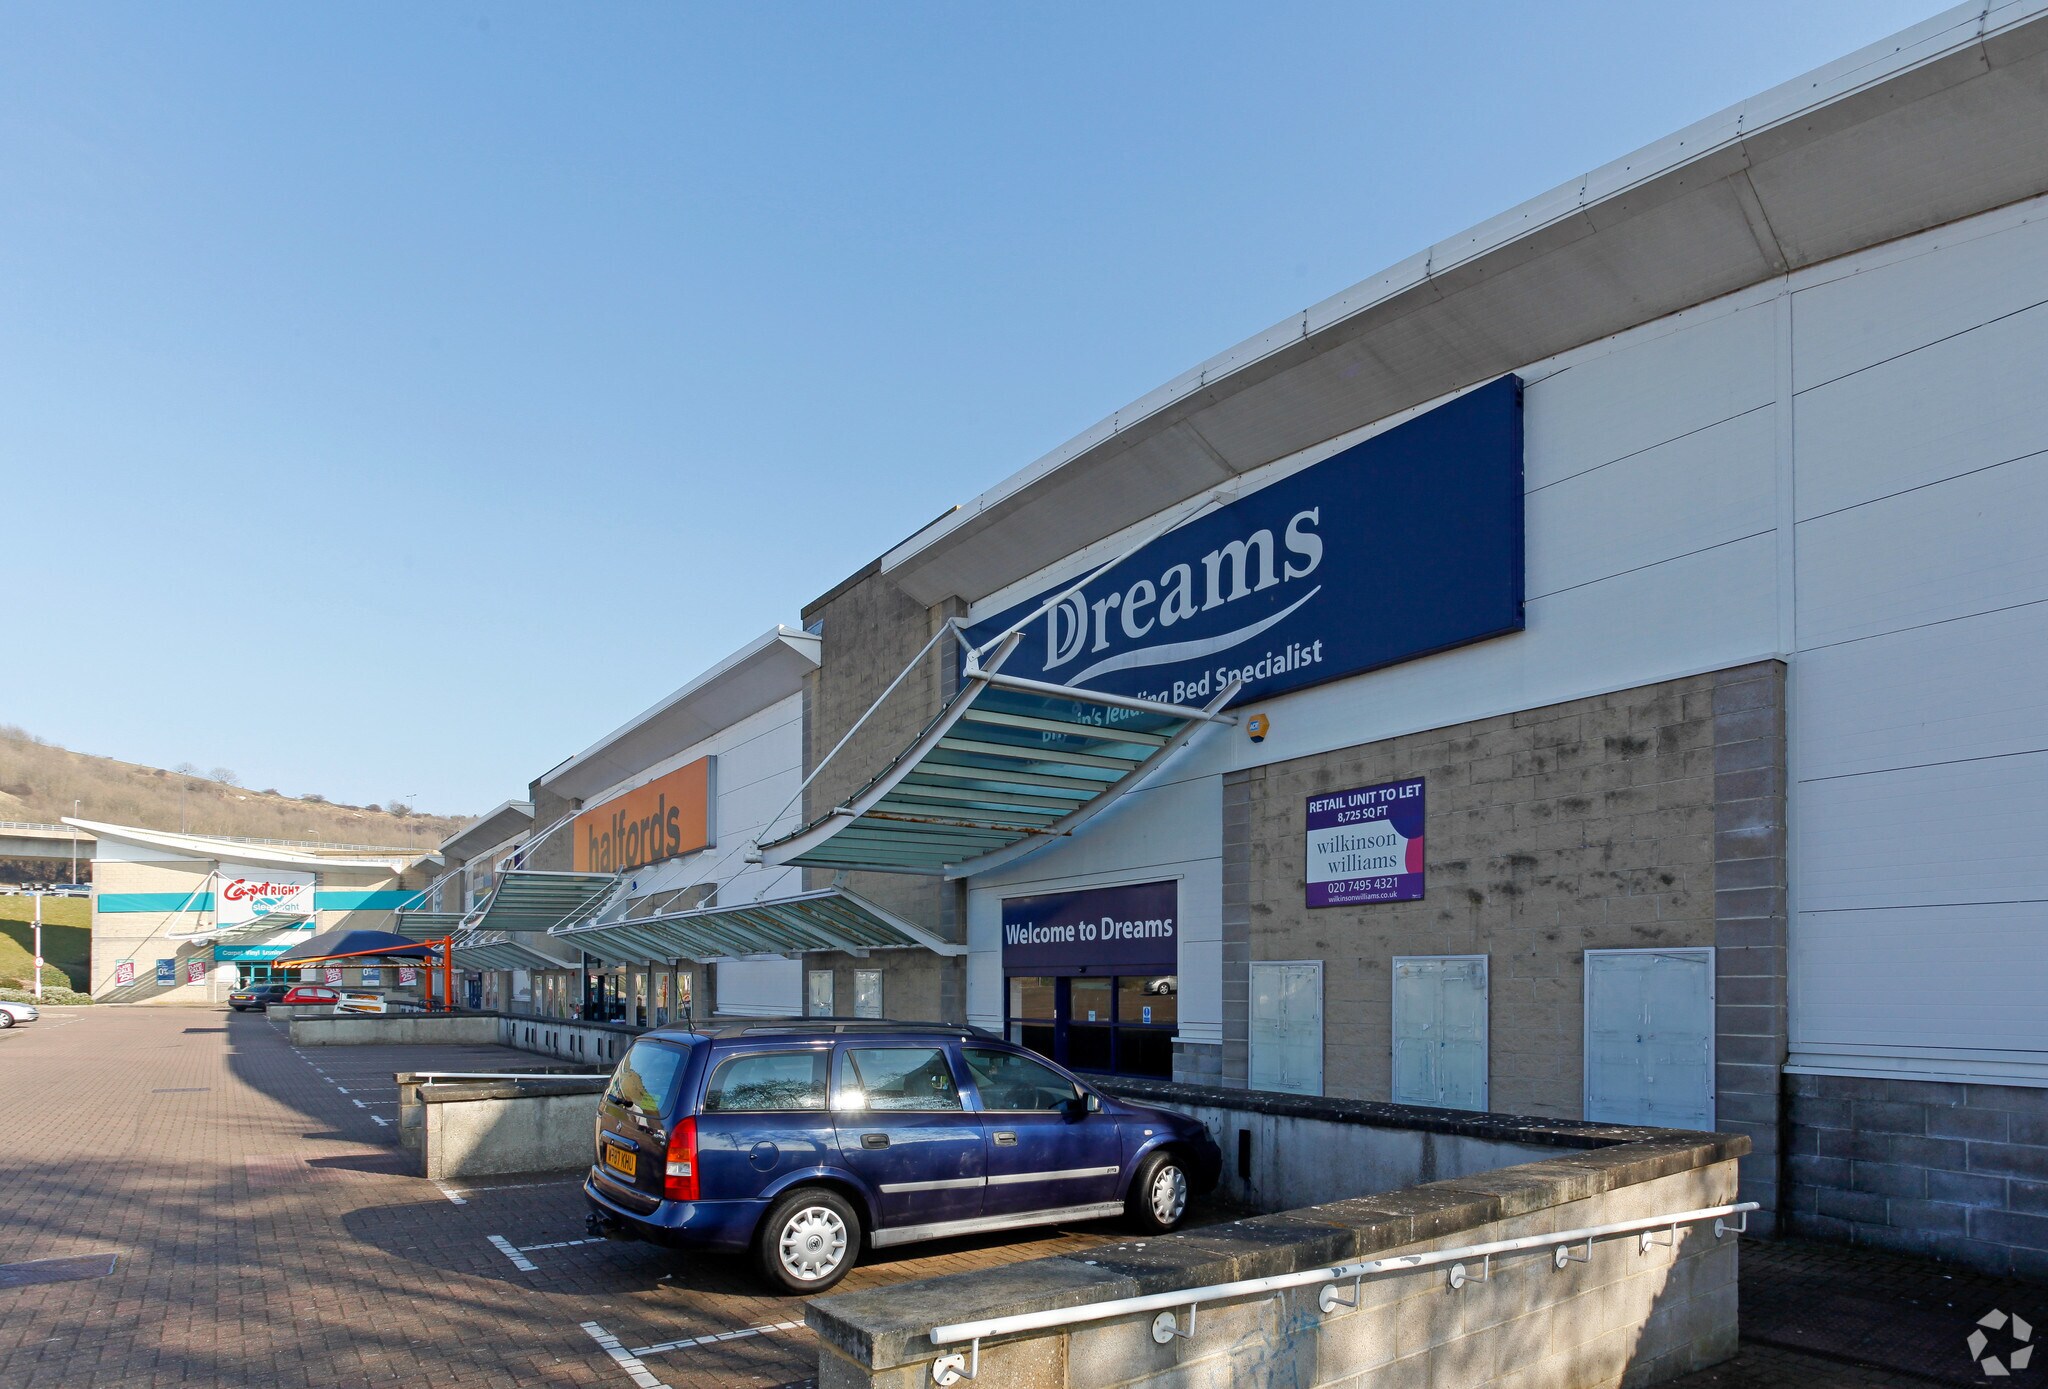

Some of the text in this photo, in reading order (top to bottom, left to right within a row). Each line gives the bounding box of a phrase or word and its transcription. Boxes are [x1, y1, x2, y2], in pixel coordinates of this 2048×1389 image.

[1042, 506, 1324, 672] Dreams
[1173, 670, 1210, 704] Bed
[1215, 639, 1323, 691] Specialist
[1309, 783, 1422, 813] RETAIL UNIT TO LET
[1337, 805, 1388, 823] 8,725 SQ FT
[588, 793, 681, 873] halfords
[1317, 833, 1398, 855] wilkinson
[1328, 853, 1397, 874] williams
[1328, 877, 1398, 894] 020 7495 4321
[1328, 891, 1398, 903] wilkinsonwilliams.co.uk
[1005, 916, 1173, 945] Welcome to Dreams
